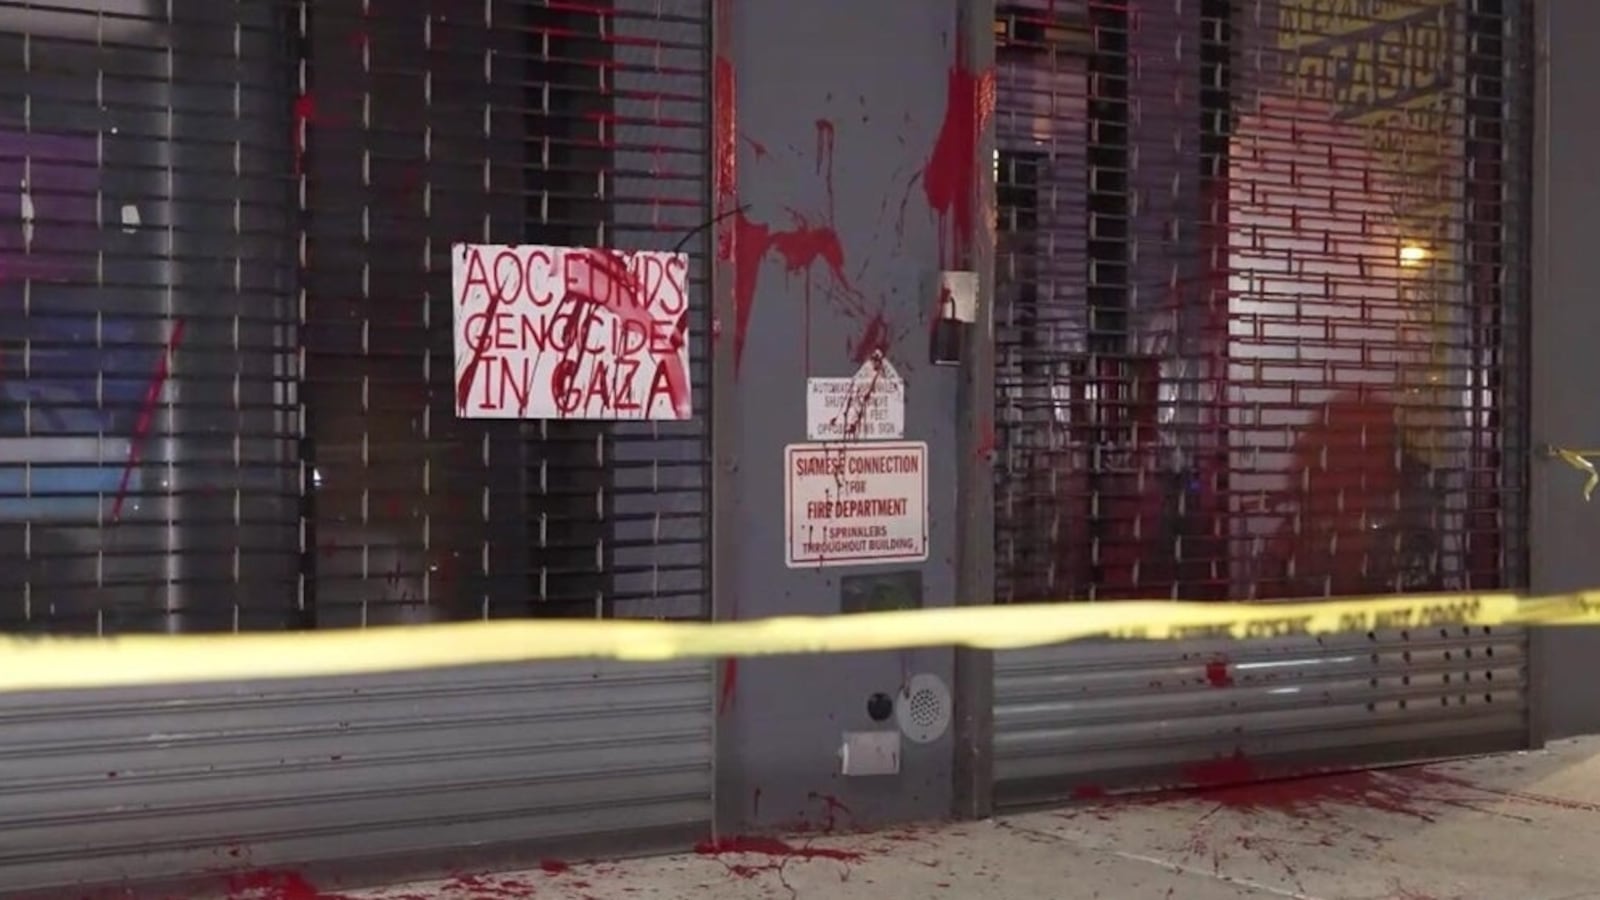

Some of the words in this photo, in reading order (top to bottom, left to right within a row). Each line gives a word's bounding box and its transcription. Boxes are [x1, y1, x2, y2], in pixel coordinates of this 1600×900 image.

[460, 250, 553, 307] AOC
[564, 252, 684, 314] FUNDS
[464, 313, 675, 354] GENOCIDE
[479, 357, 529, 409] IN
[551, 358, 679, 413] GAZA
[796, 456, 845, 476] SIAMESE
[848, 455, 918, 474] CONNECTION
[850, 480, 867, 493] FOR
[807, 501, 833, 519] FIRE
[835, 498, 907, 518] DEPARTMENT
[829, 525, 887, 539] SPRINKLERS
[803, 540, 866, 555] THROUGHOUT
